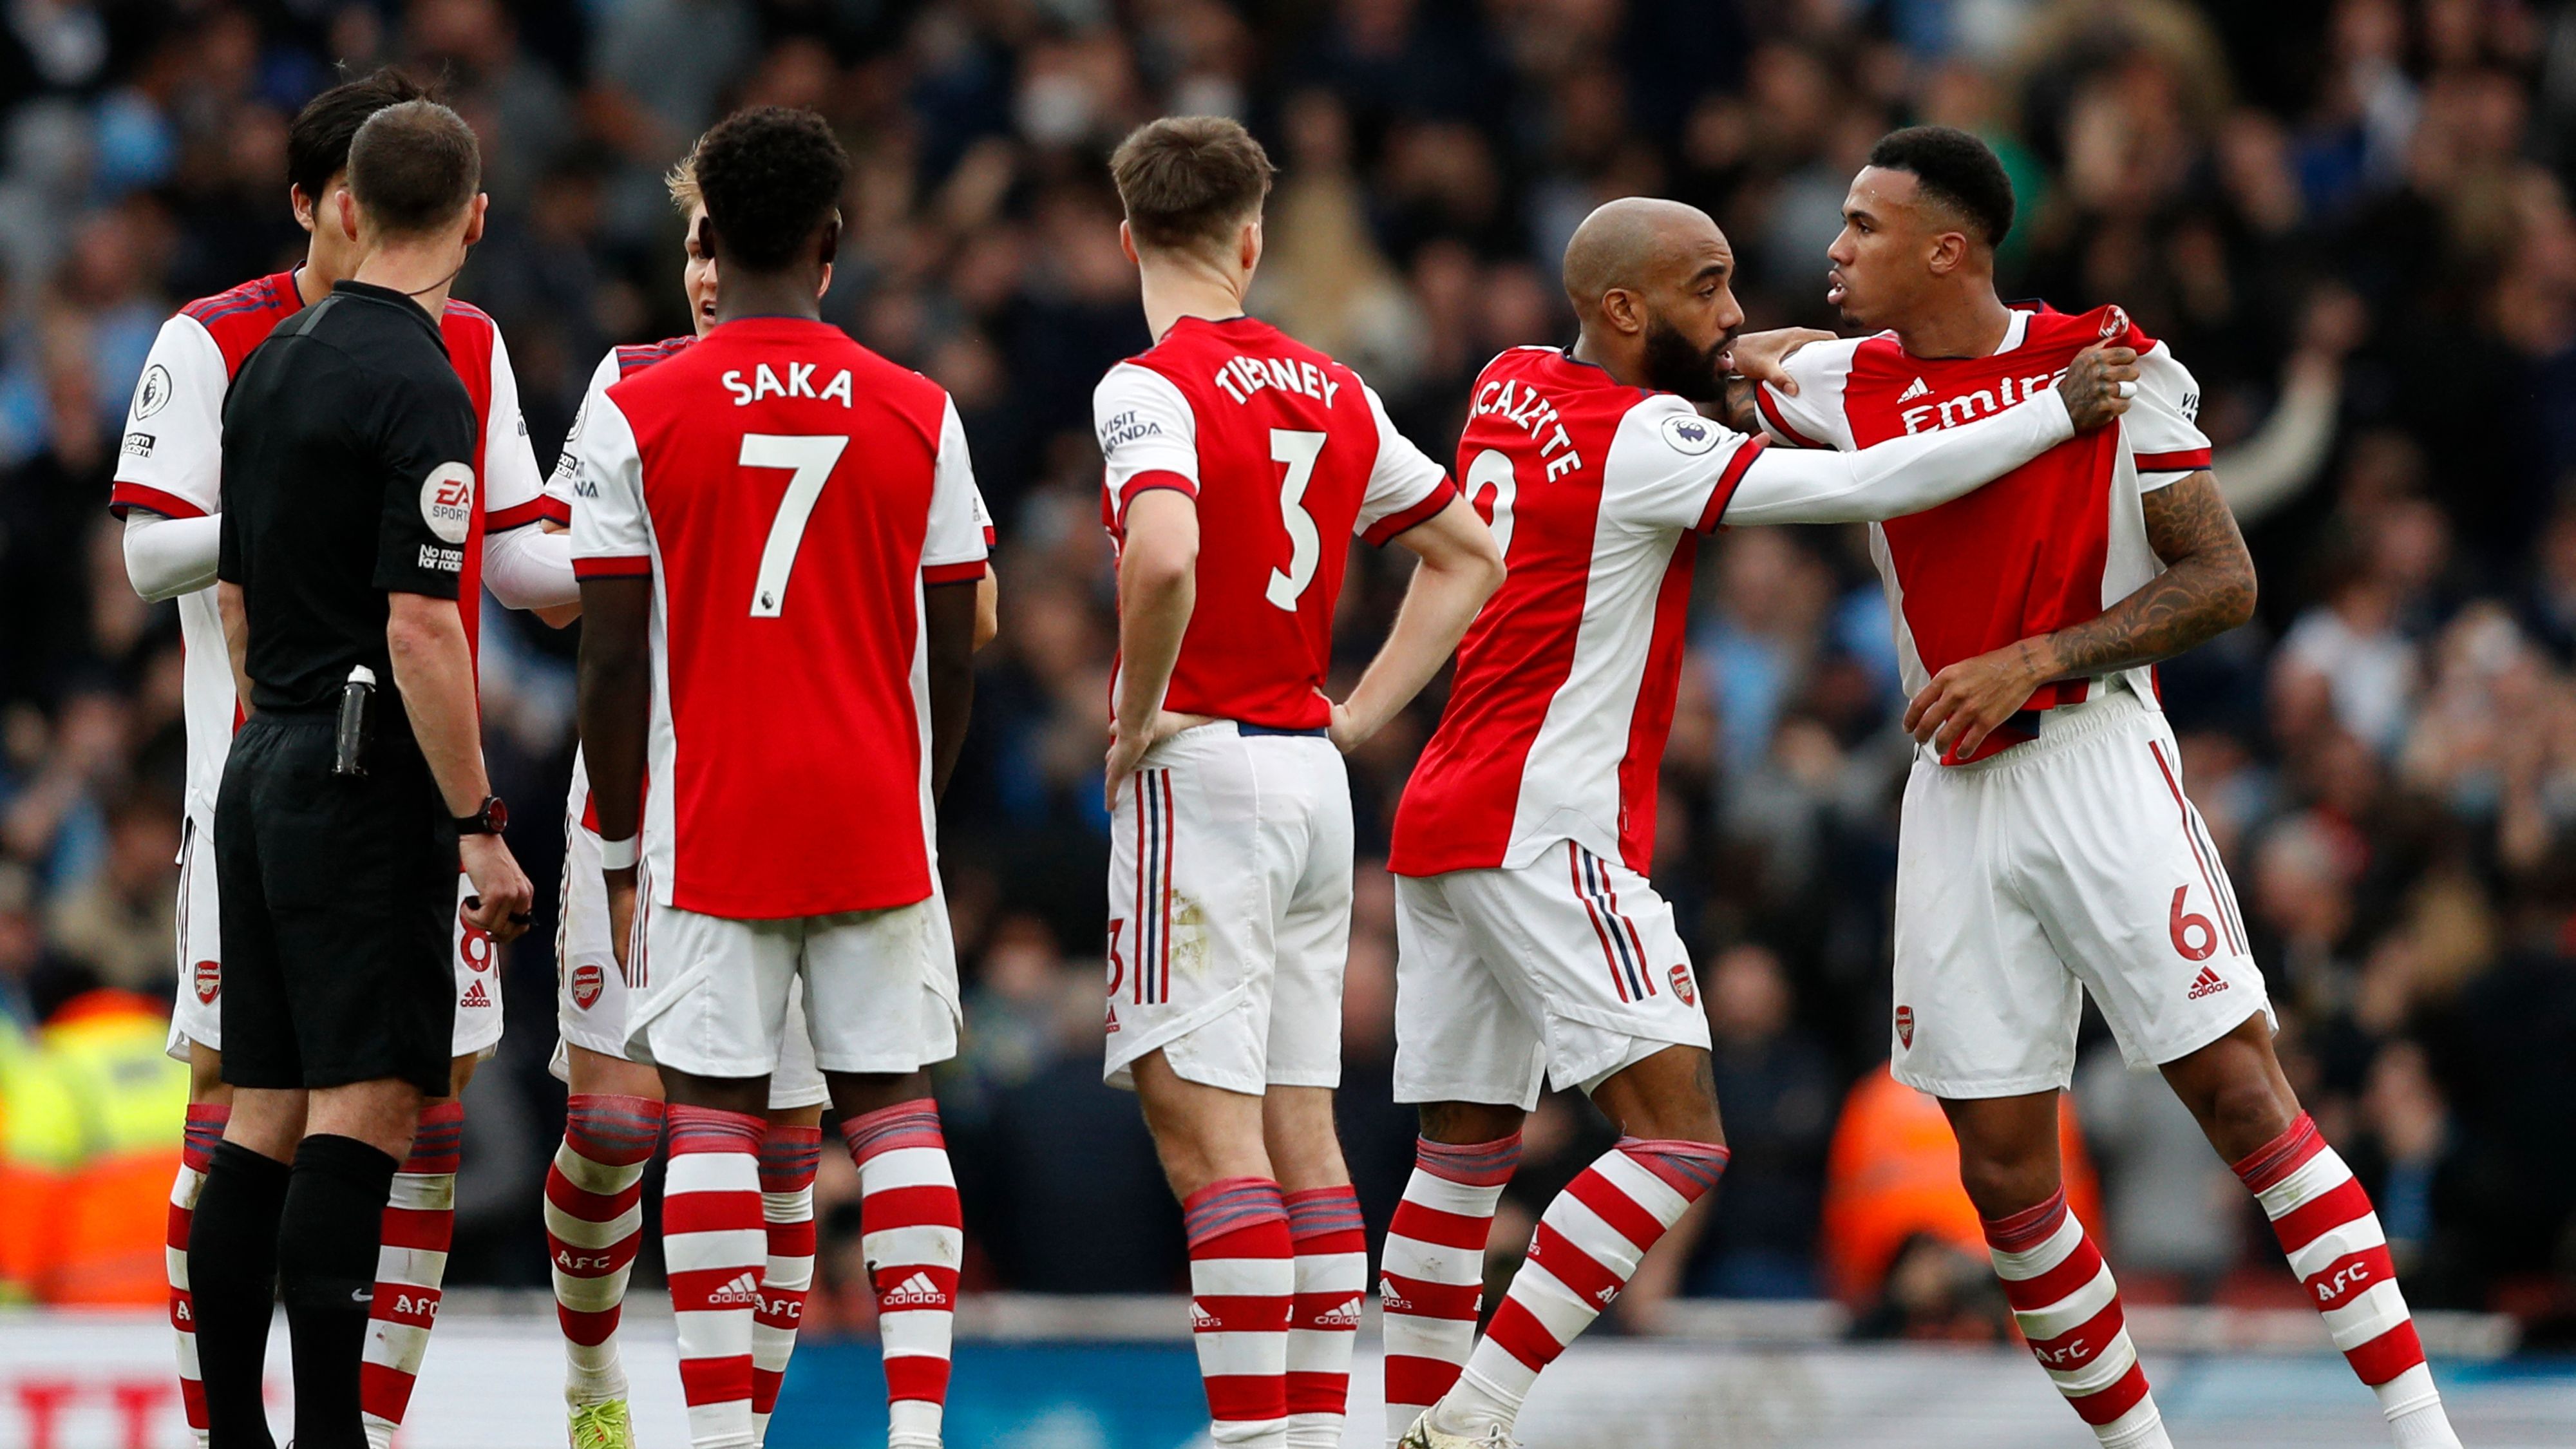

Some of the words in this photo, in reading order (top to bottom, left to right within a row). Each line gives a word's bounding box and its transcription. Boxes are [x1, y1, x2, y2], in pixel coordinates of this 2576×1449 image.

[722, 362, 852, 408] SAKA
[1215, 355, 1339, 409] TIERNEY
[1100, 410, 1137, 439] VISIT
[435, 479, 470, 508] EA
[433, 506, 469, 522] SPORT
[738, 433, 849, 618] 7
[1265, 428, 1327, 612] 3
[418, 555, 437, 569] for
[419, 544, 439, 558] No
[2170, 884, 2217, 961] 6
[2188, 981, 2229, 999] adidas
[557, 1250, 611, 1269] AFC
[2316, 1262, 2369, 1301] AFC
[754, 1294, 802, 1318] AFC
[883, 1291, 946, 1305] adidas
[2035, 1339, 2090, 1363] AFC
